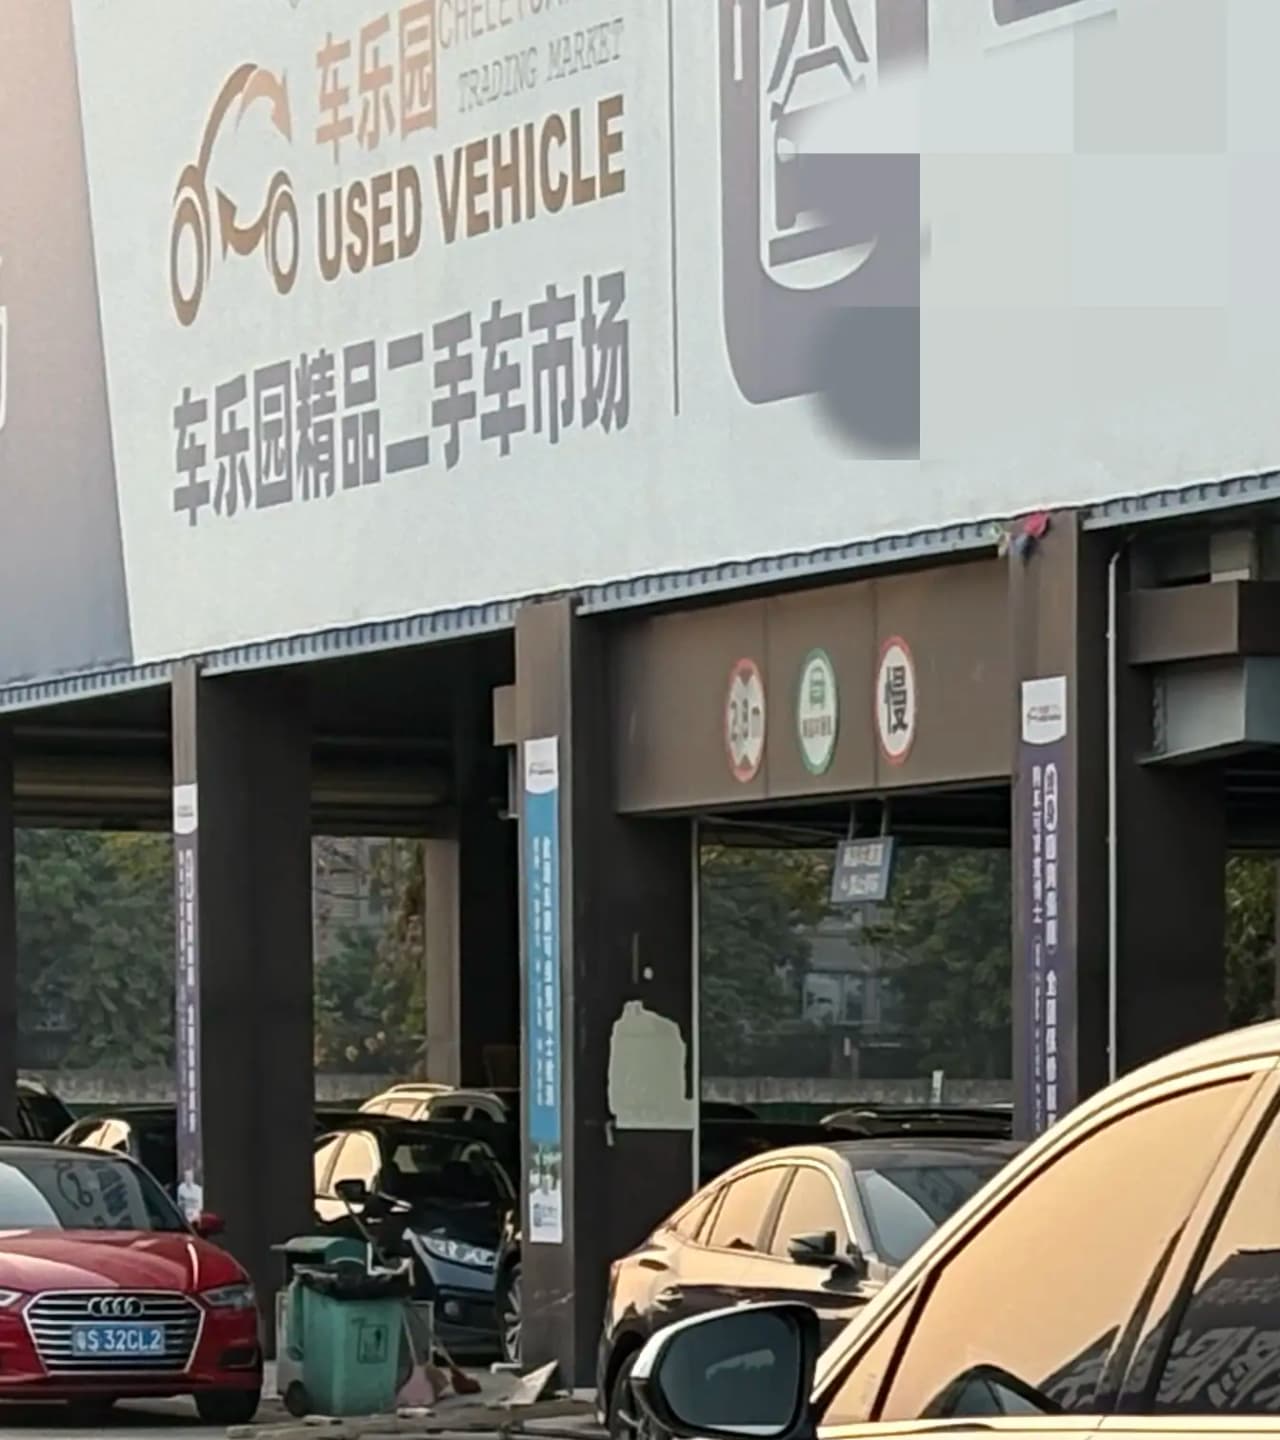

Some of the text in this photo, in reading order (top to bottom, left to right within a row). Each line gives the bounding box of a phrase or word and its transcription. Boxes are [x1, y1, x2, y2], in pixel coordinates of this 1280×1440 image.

[315, 0, 437, 165] 车乐园
[458, 46, 538, 114] TRADING
[546, 17, 624, 81] MARKET
[317, 165, 422, 281] USED
[434, 94, 625, 244] VEHICLE
[173, 271, 630, 526] 车乐园精品二手车市场
[884, 665, 909, 734] 慢
